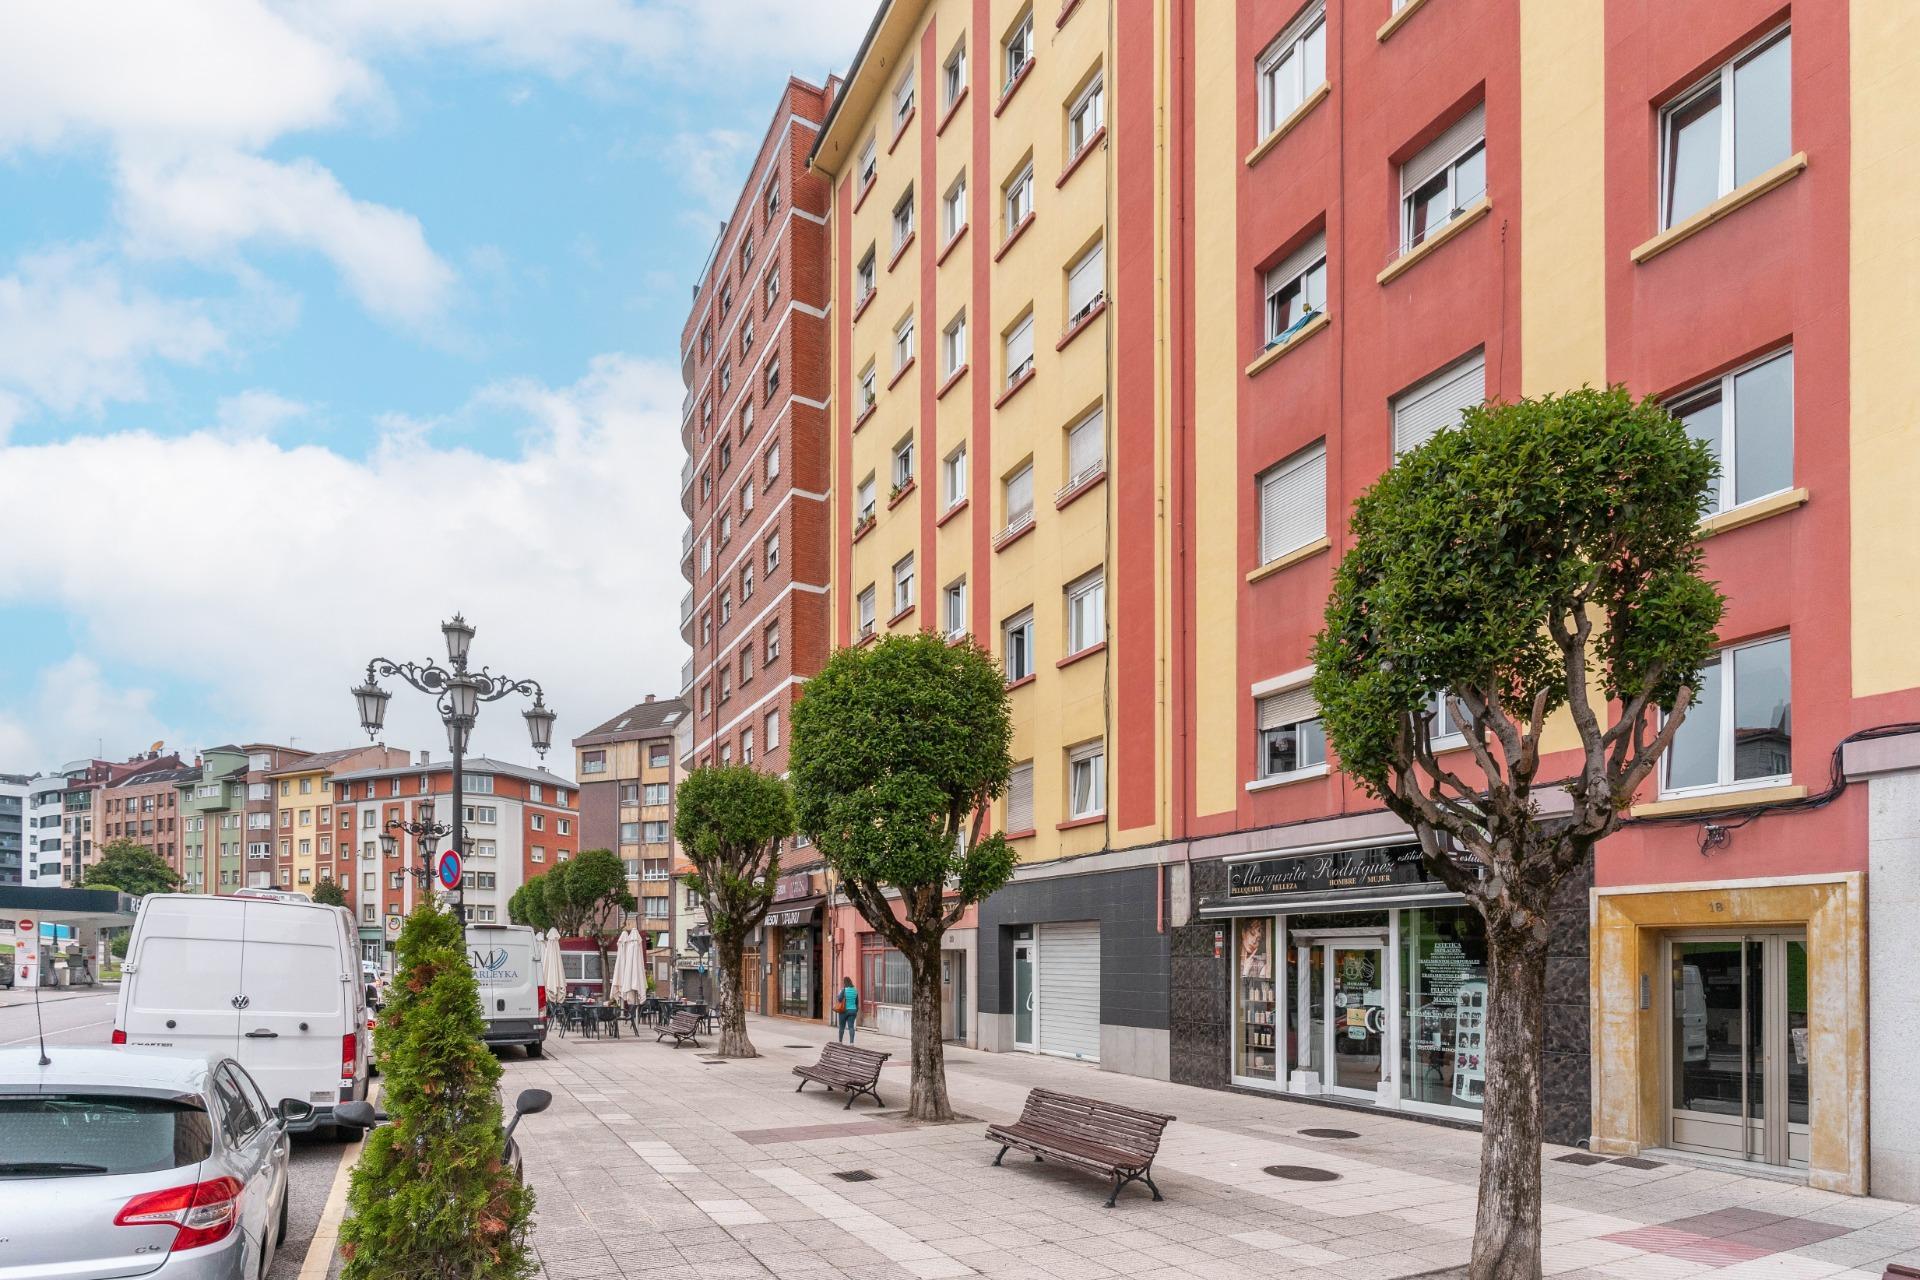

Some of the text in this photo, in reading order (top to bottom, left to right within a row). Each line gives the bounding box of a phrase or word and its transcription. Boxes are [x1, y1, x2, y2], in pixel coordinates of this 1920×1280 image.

[1232, 864, 1307, 890] Margarita
[1272, 882, 1298, 891] BELLEZA
[1329, 877, 1357, 886] HOMBRE
[1367, 874, 1391, 884] MUJER
[473, 970, 518, 979] ARLEYKA
[135, 1245, 161, 1253] C4
